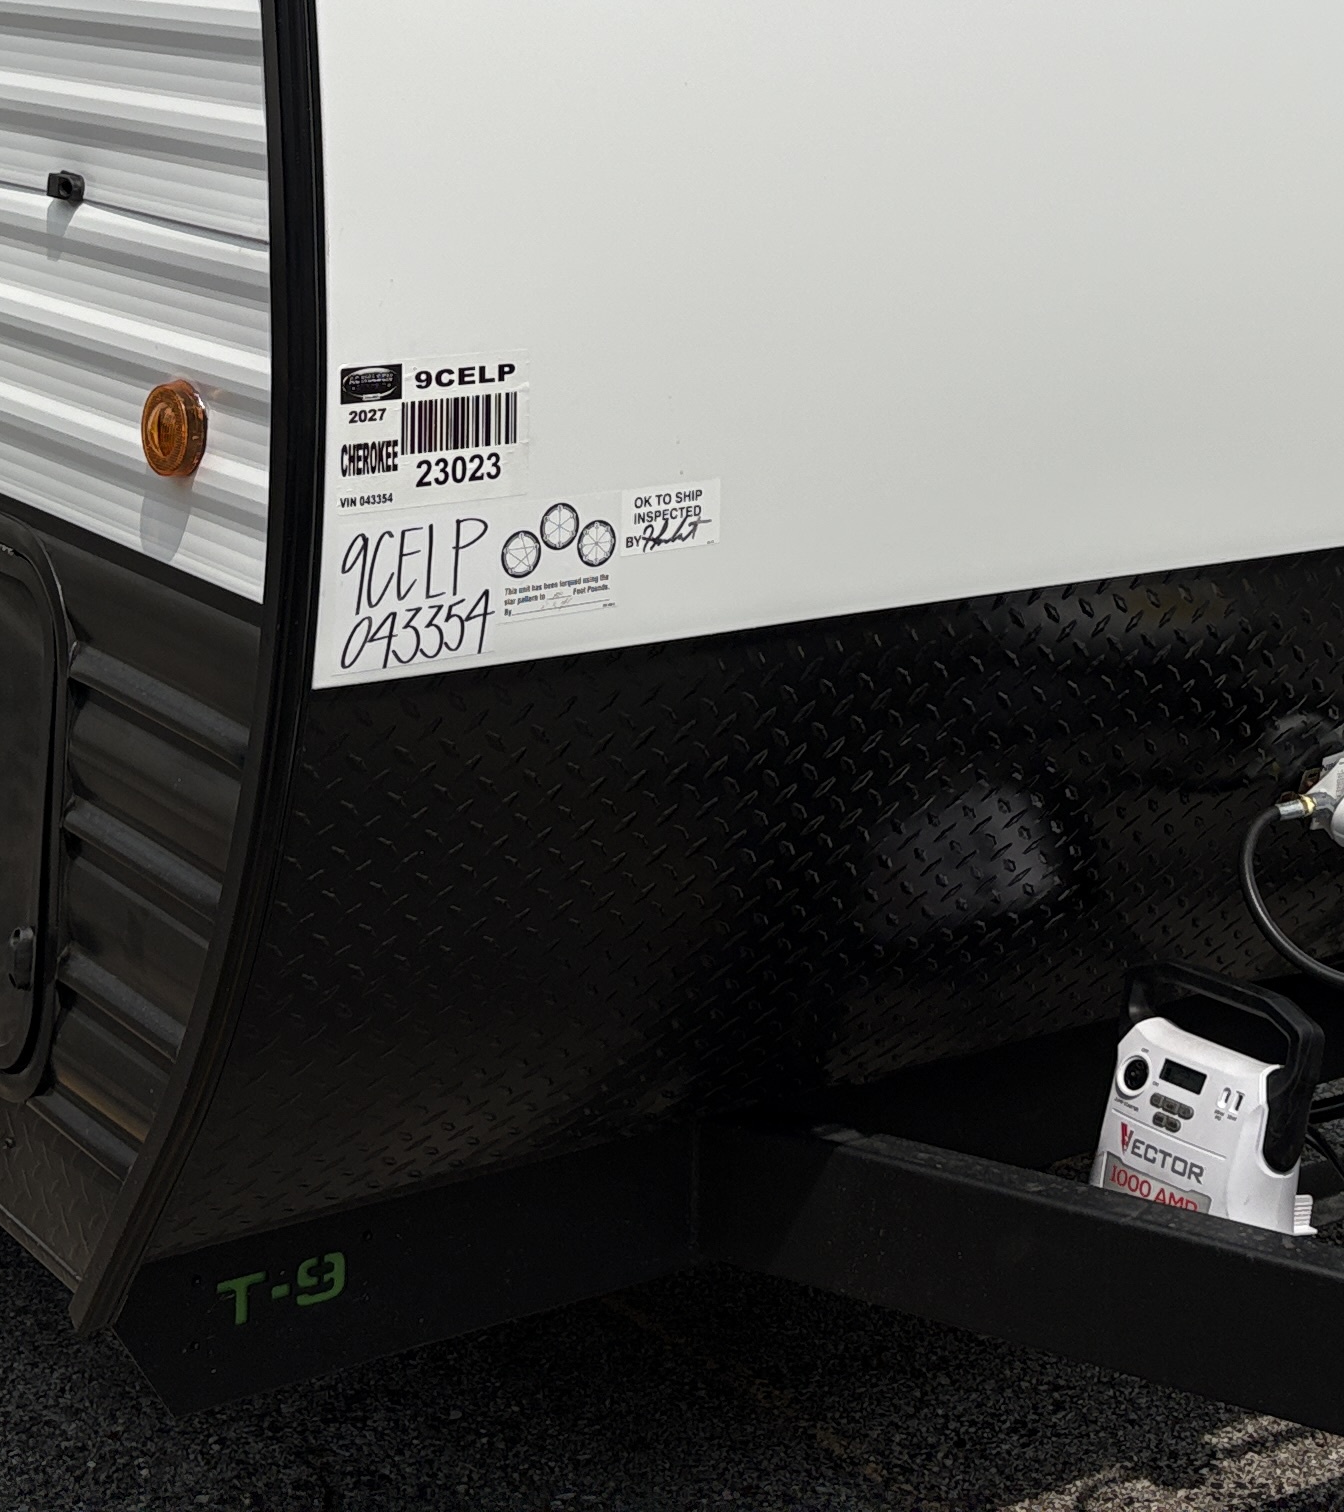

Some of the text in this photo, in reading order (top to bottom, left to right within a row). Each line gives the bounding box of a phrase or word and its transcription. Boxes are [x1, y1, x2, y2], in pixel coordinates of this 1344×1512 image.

[414, 363, 516, 389] 9CELP
[348, 408, 387, 424] 2027
[340, 439, 399, 477] CHEROKEE
[415, 452, 502, 488] 23023
[340, 493, 393, 508] VIN 043354
[634, 489, 703, 509] OK TO SHIP
[634, 505, 702, 525] INSPECTED
[625, 535, 641, 548] BY
[341, 517, 488, 616] 9CELP
[340, 589, 495, 669] 043354
[1121, 1122, 1204, 1185] VECTOR
[1110, 1165, 1152, 1198] 1000
[217, 1251, 346, 1326] T-9
